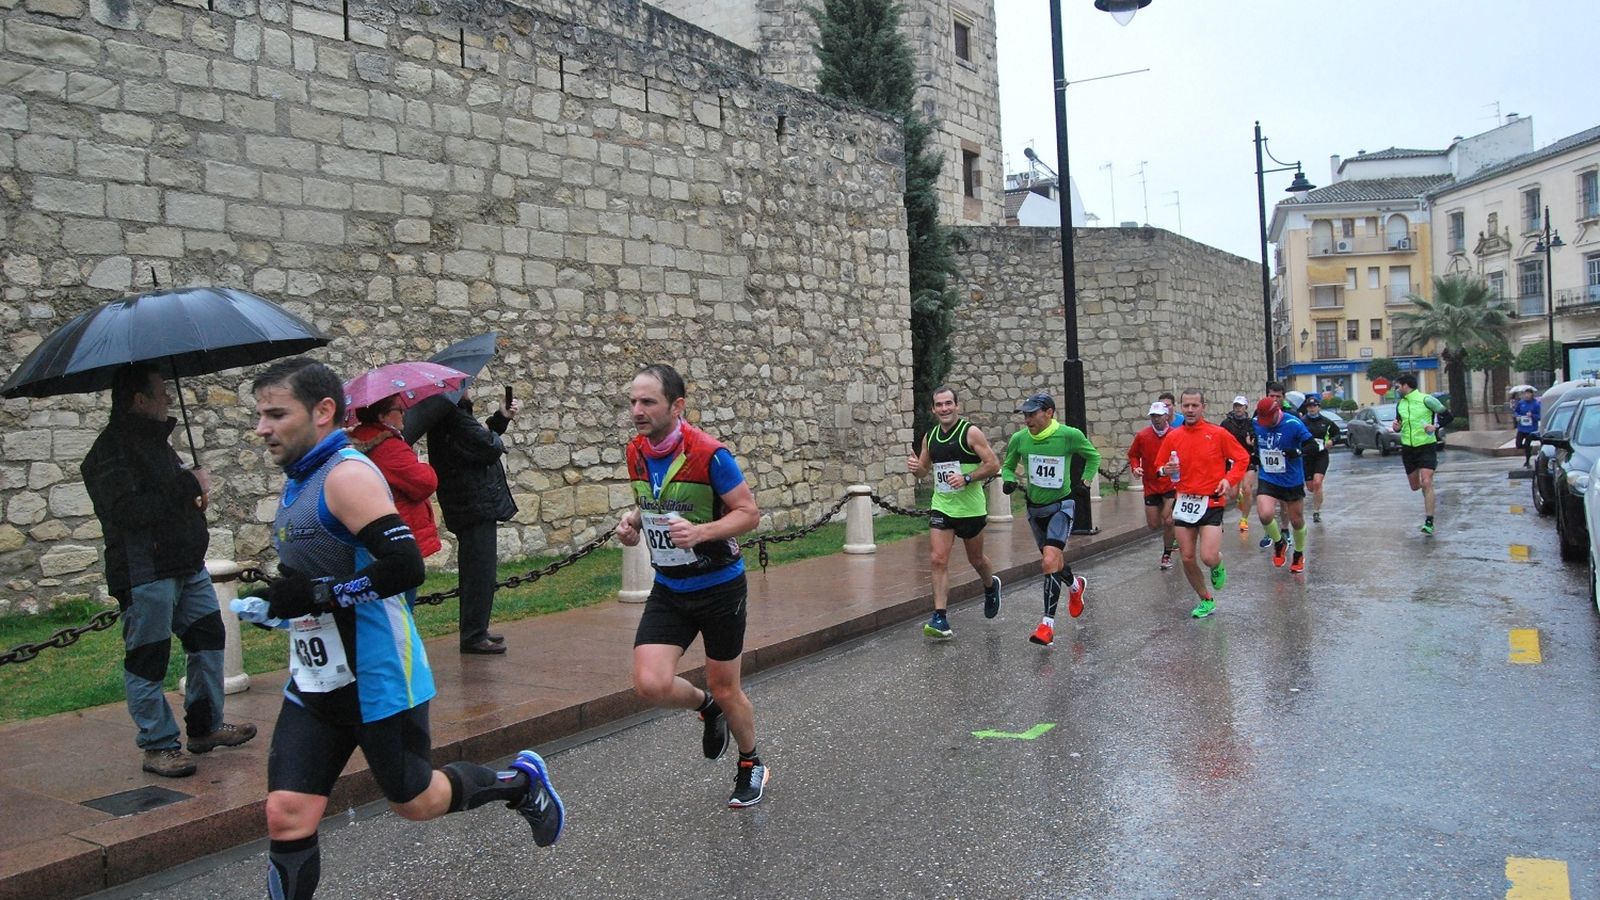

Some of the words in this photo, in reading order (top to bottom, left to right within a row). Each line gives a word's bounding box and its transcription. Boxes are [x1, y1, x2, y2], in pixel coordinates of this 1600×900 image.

[1265, 457, 1279, 466] 104
[937, 470, 955, 483] 90
[1036, 465, 1056, 478] 414
[1180, 502, 1201, 515] 592
